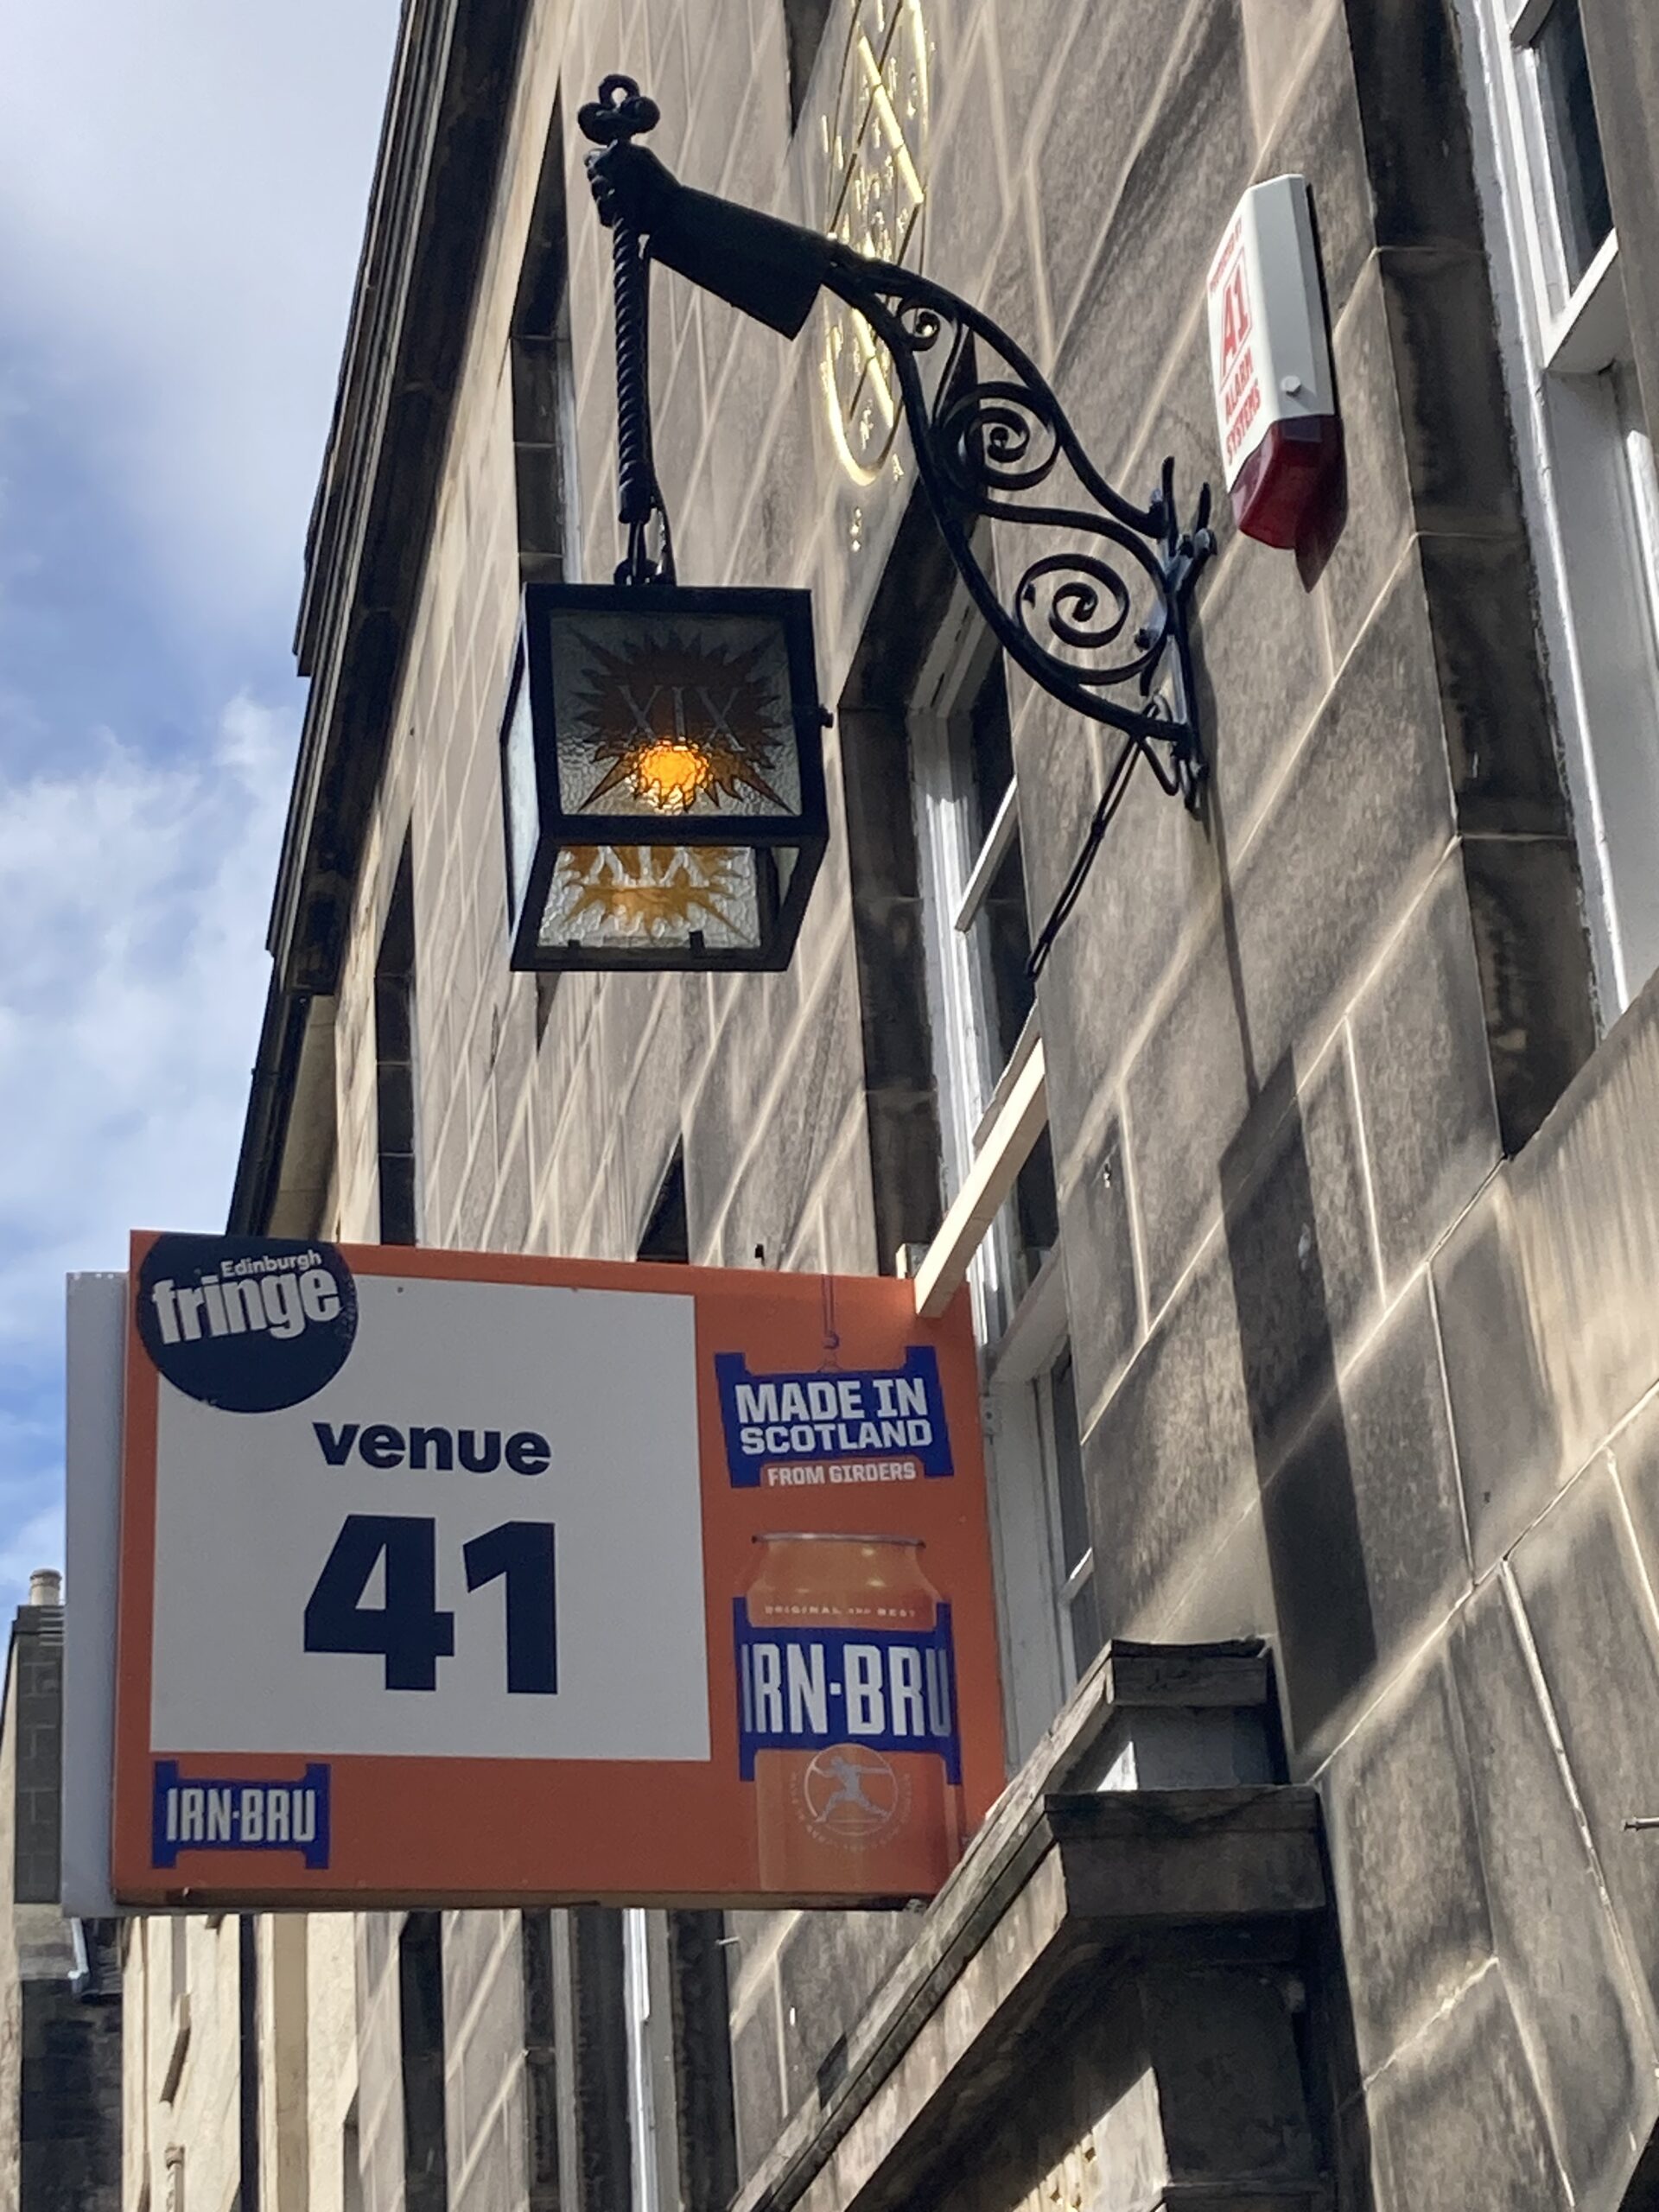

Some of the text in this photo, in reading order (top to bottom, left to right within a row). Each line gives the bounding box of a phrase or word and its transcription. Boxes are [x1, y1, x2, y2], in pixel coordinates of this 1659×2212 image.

[1222, 263, 1249, 378] A1
[1225, 347, 1253, 424] ALARM
[1226, 378, 1261, 466] SYSTEMS
[220, 1249, 322, 1278] Edinburgh
[152, 1268, 343, 1344] fringe
[734, 1377, 929, 1424] MADE IN
[312, 1421, 551, 1476] venue
[740, 1419, 933, 1455] SCOTLAND
[767, 1462, 917, 1487] FROM GIRDERS
[303, 1514, 558, 1694] 41
[741, 1643, 951, 1736] IRN-BRU
[166, 1787, 316, 1843] IRN-BRU
